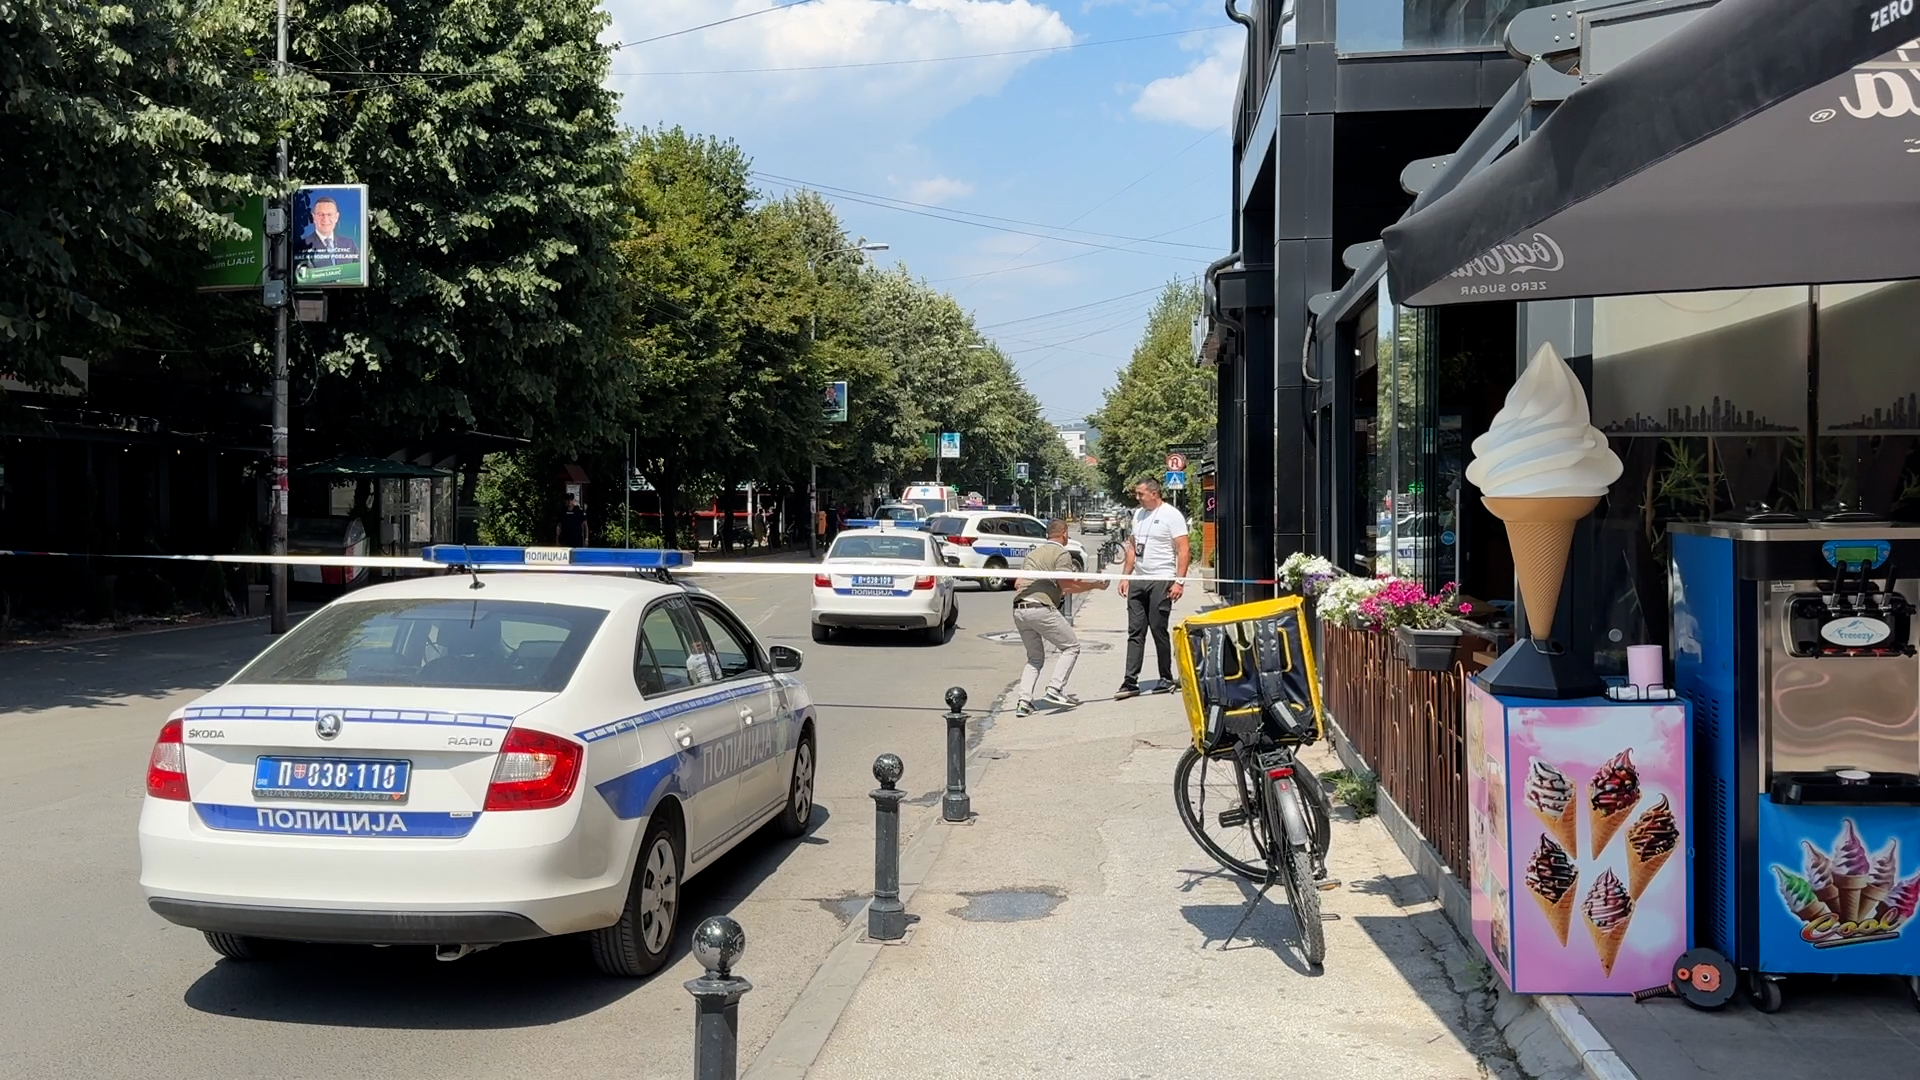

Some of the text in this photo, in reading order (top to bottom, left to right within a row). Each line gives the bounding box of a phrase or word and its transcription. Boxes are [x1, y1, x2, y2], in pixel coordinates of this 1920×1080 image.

[1870, 0, 1914, 33] ZERO
[525, 552, 568, 561] ПОЛИЦИЈА
[851, 589, 894, 597] ПОЛИЦИЈА
[448, 737, 493, 747] RAPID
[702, 724, 772, 785] ПОЛИЦИЈА
[278, 761, 396, 789] П 038-110
[256, 808, 407, 834] ПОЛИЦИЈА
[1800, 906, 1900, 944] Cool
